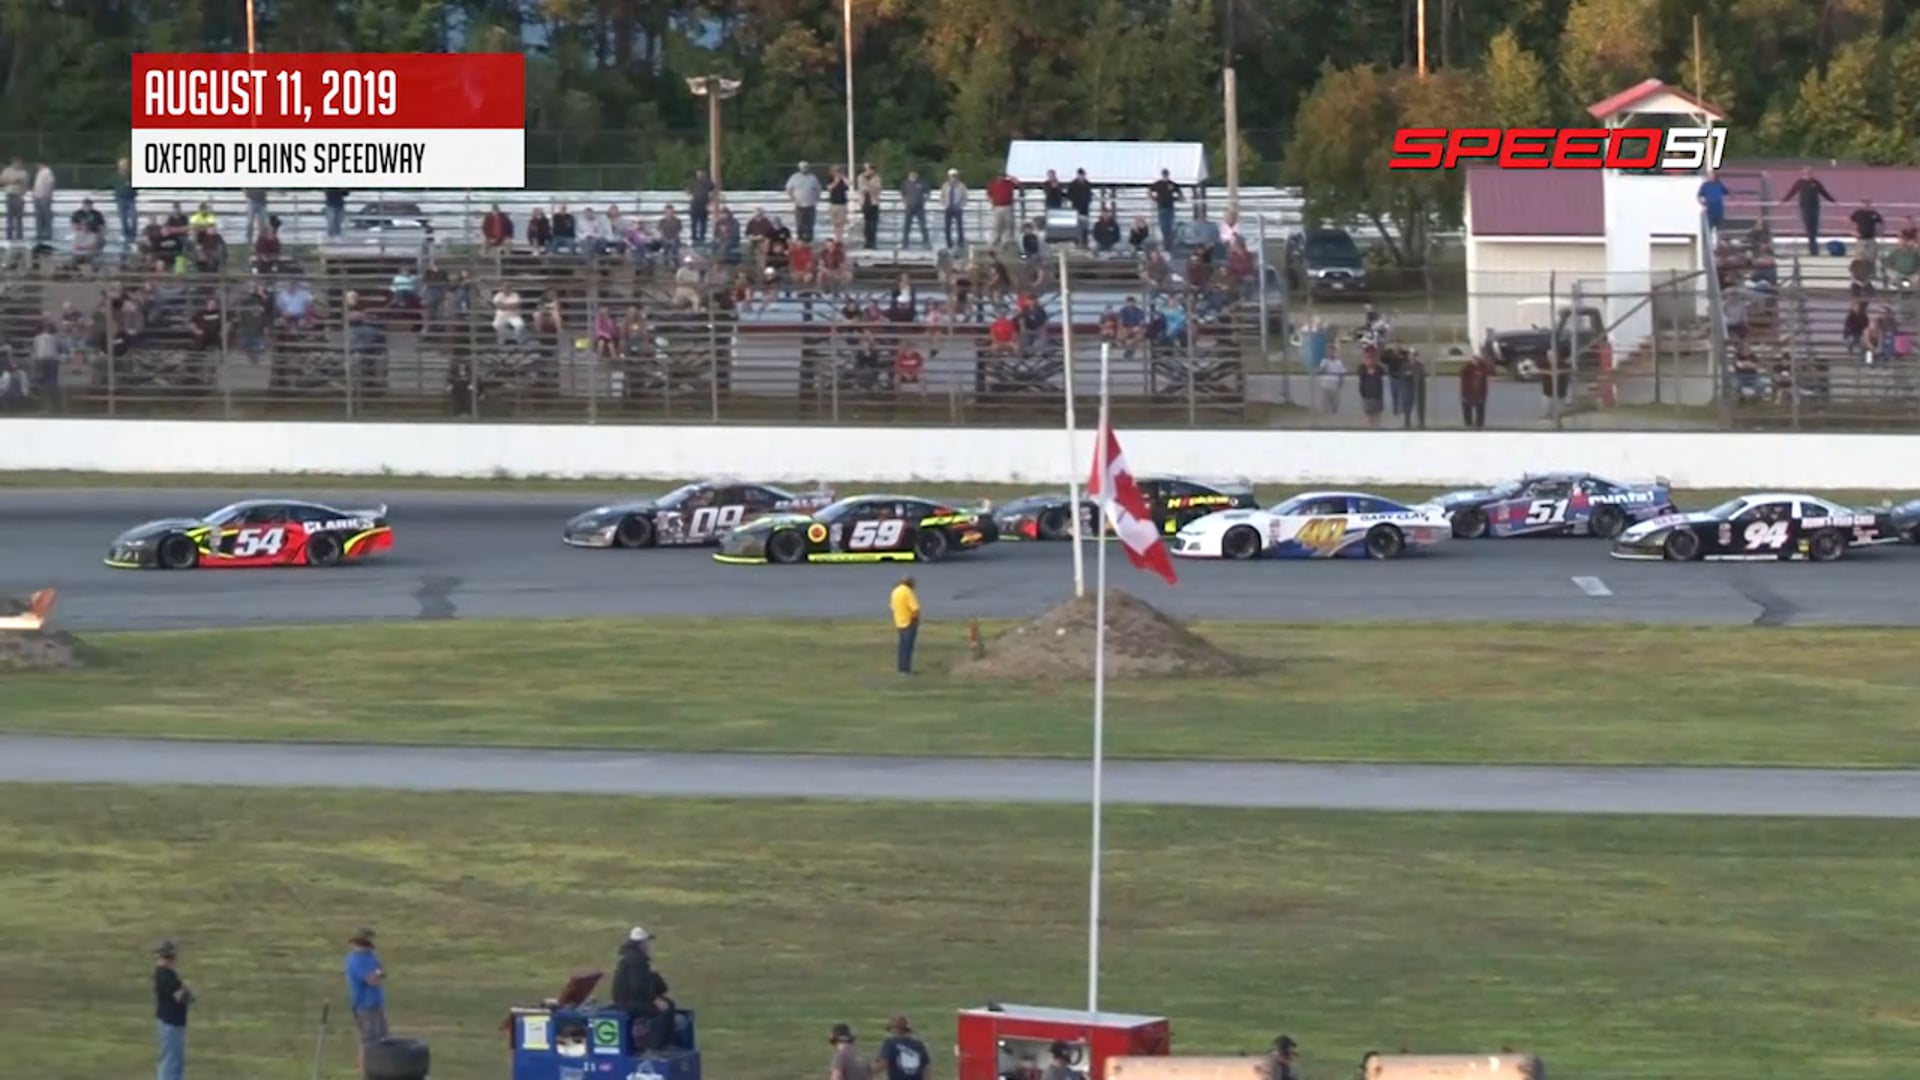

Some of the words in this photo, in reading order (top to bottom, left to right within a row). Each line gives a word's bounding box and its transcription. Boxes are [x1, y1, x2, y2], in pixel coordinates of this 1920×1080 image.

[689, 505, 744, 538] 09
[1525, 499, 1568, 524] 51
[234, 528, 284, 556] 54
[849, 520, 904, 548] 59
[1744, 521, 1788, 549] 94
